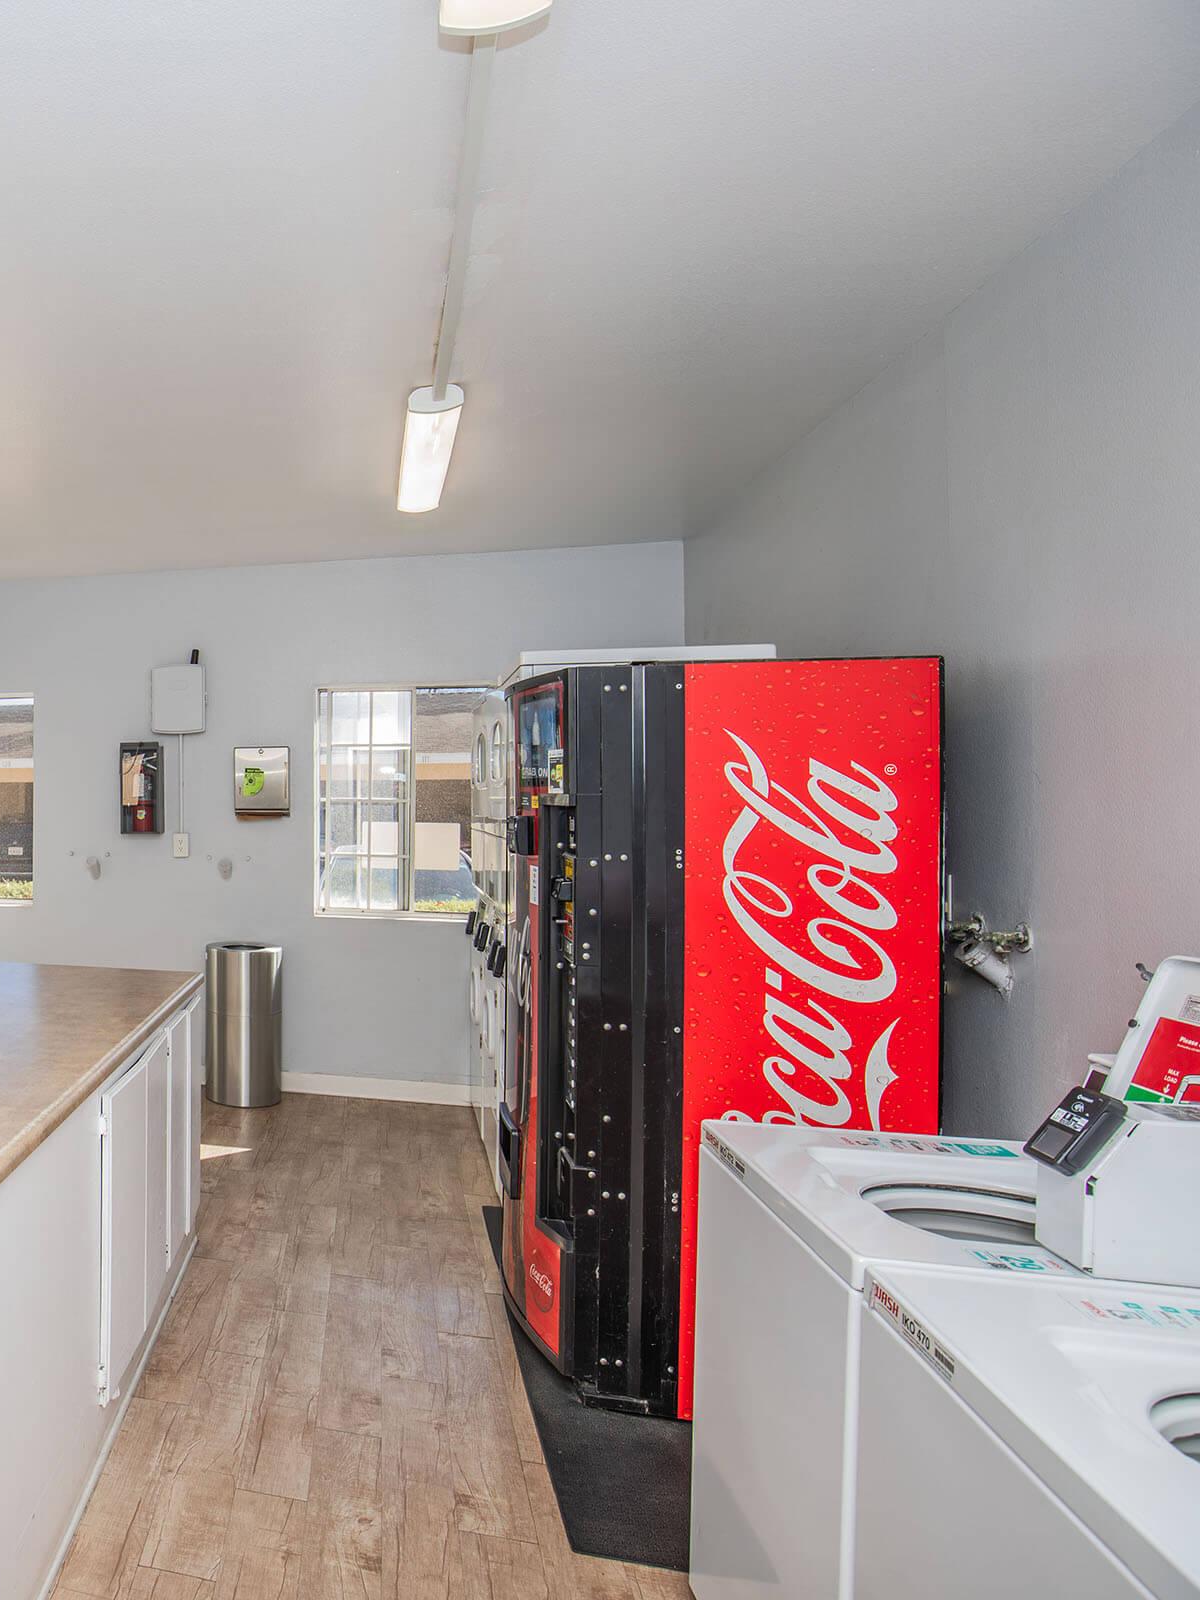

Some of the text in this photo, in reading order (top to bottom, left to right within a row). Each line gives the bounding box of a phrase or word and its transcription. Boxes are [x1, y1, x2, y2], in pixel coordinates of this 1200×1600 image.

[1167, 1067, 1180, 1078] MAX
[1163, 1074, 1178, 1085] LOAD
[902, 1312, 916, 1336] IKO
[916, 1328, 932, 1351] 470
